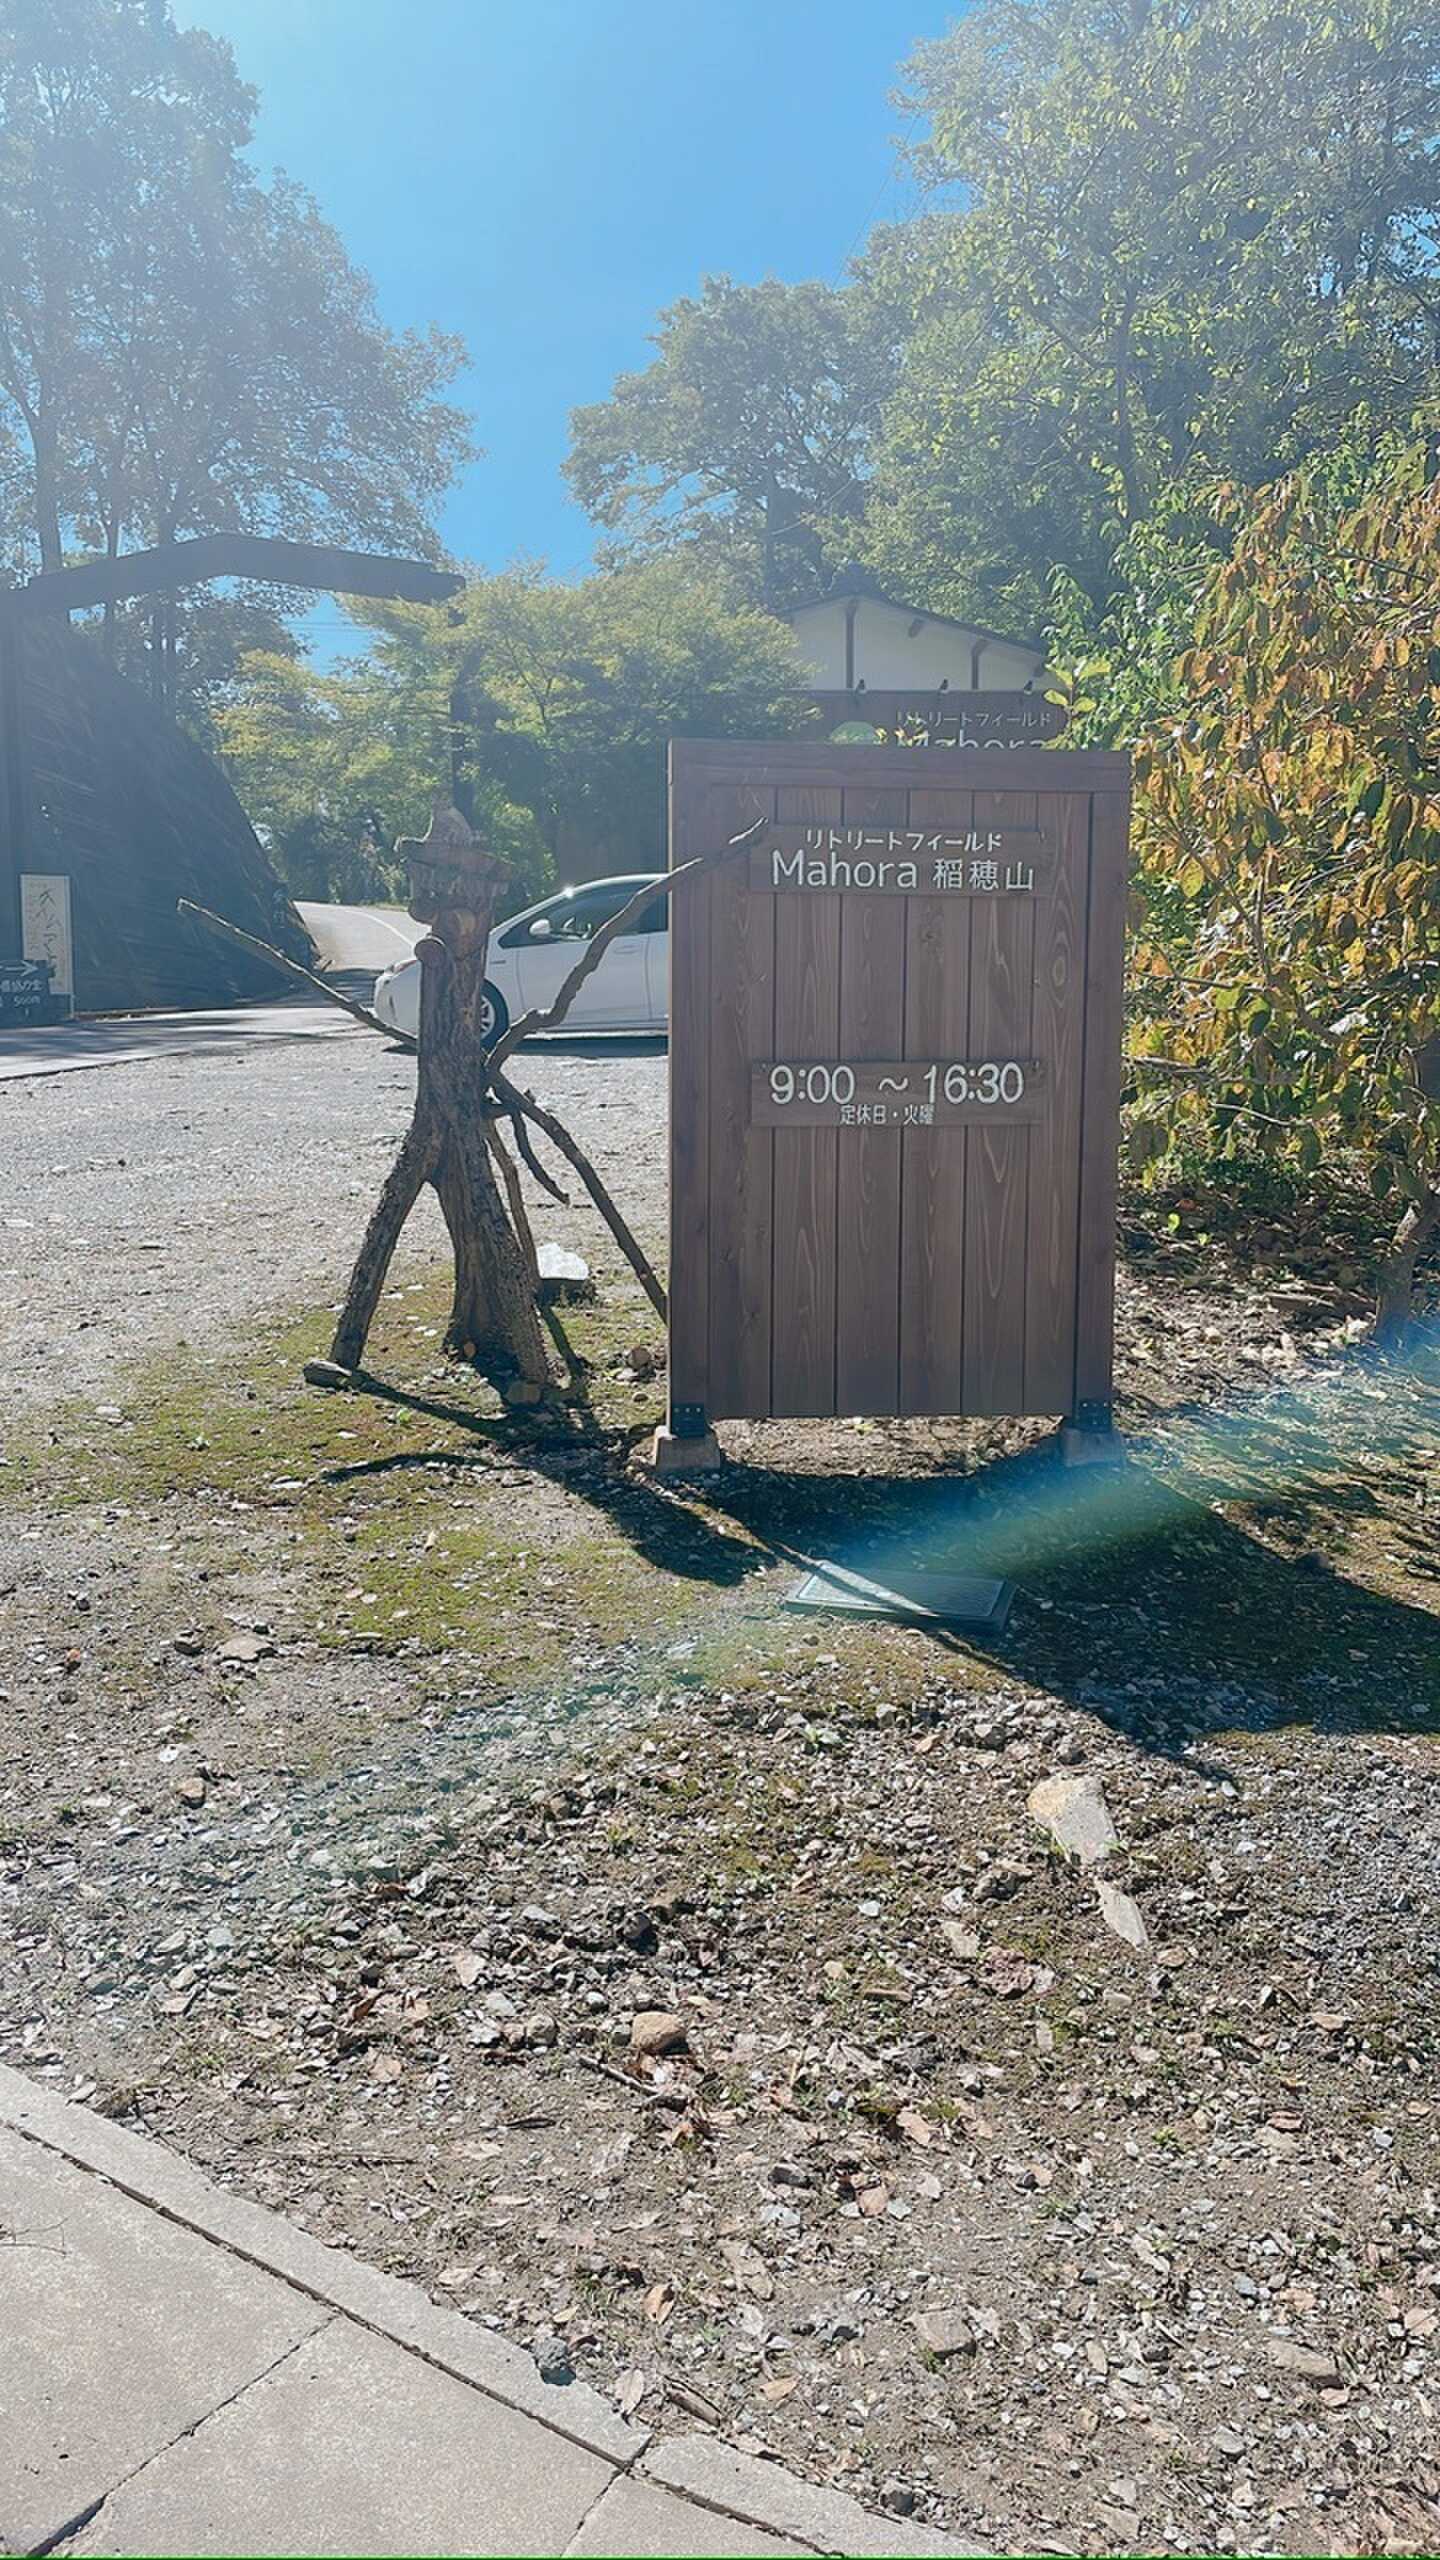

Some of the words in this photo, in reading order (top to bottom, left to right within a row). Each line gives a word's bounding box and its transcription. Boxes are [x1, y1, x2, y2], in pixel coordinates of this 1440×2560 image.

[805, 828, 1002, 853] リトリートフィールド
[771, 850, 917, 889] Mahora
[931, 857, 1034, 891] 稲穂山
[769, 1064, 856, 1104] 9:00
[922, 1062, 1024, 1104] 16:30
[839, 1103, 935, 1126] 定休日・火曜
